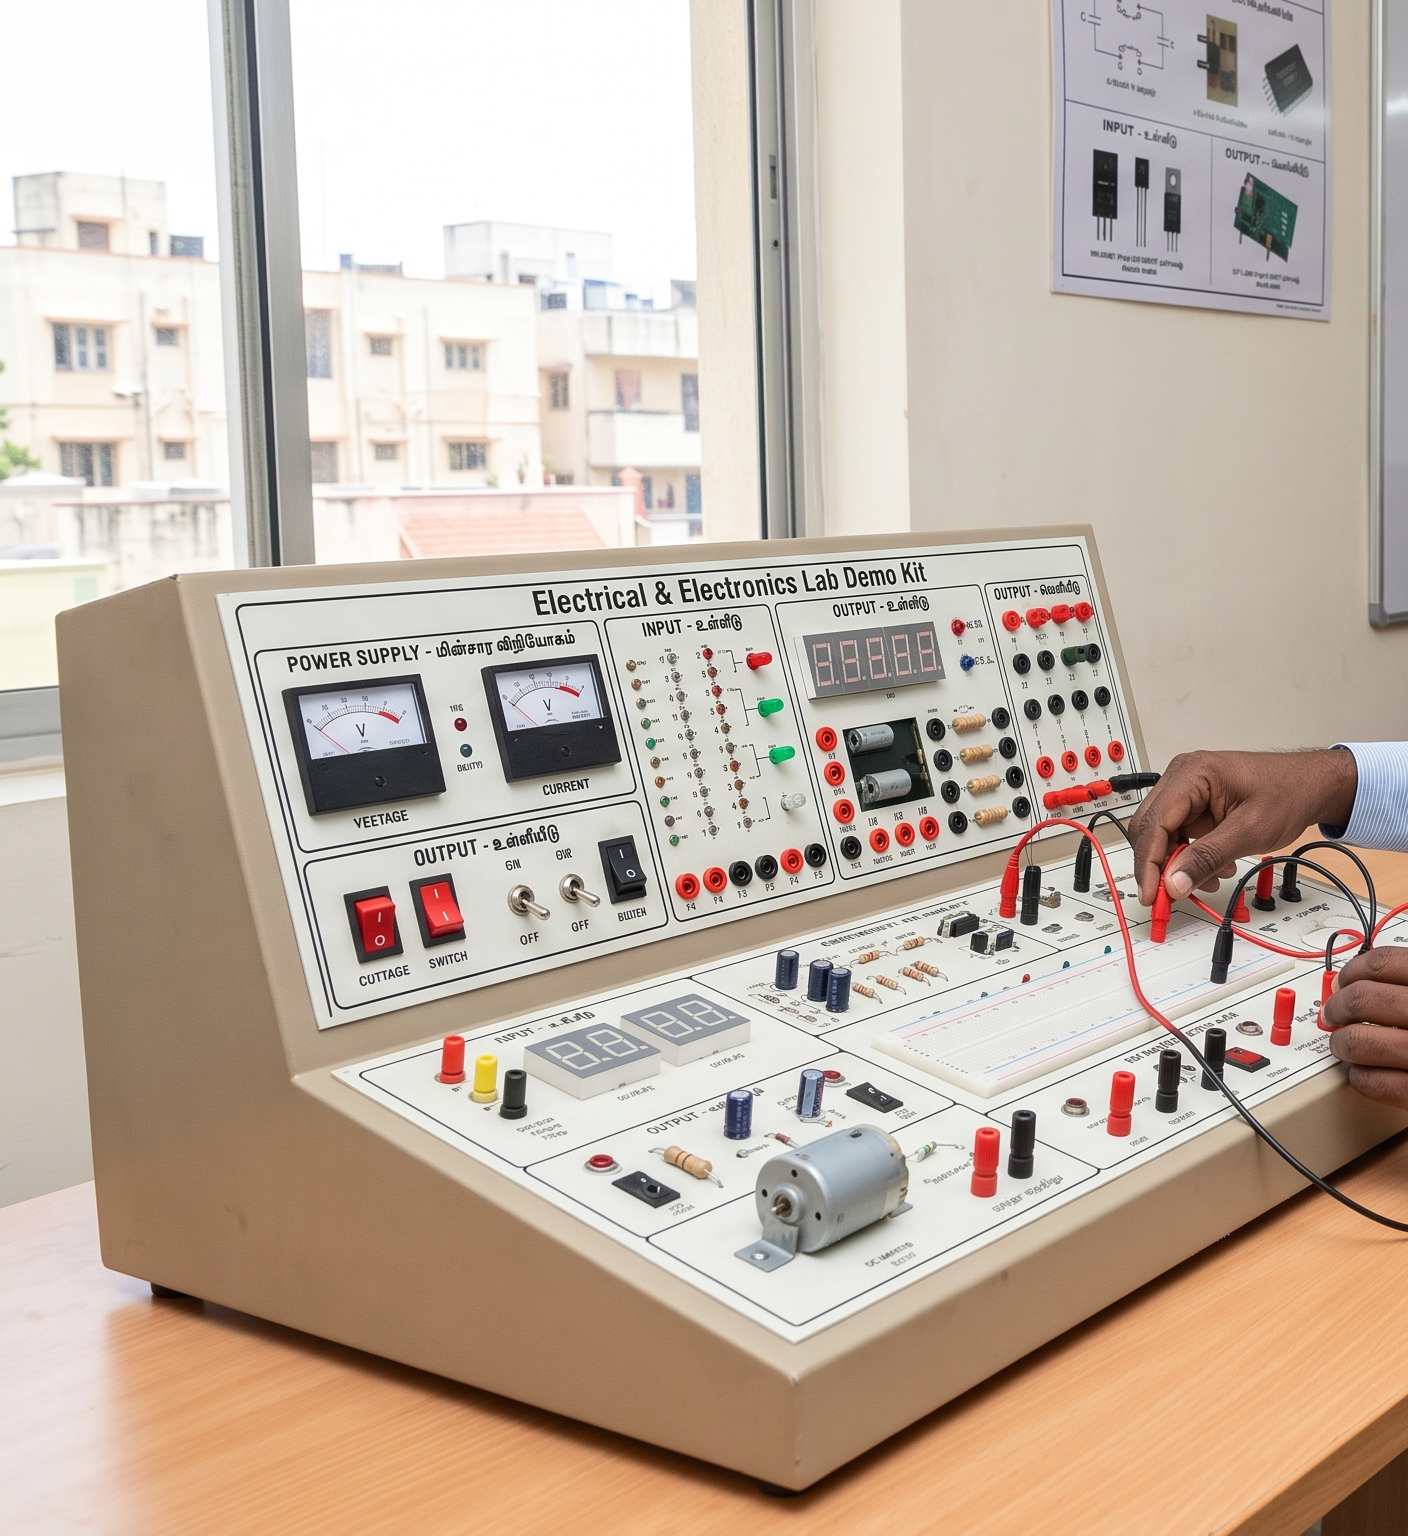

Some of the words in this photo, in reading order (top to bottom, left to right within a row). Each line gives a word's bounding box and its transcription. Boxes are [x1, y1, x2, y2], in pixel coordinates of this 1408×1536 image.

[1102, 118, 1135, 137] INPUT
[1225, 147, 1261, 165] OUTPUT
[532, 582, 648, 616] Electrical
[655, 580, 673, 606] &
[677, 571, 798, 602] Electronics
[801, 567, 839, 593] Lab
[842, 564, 897, 589] Demo
[900, 561, 928, 585] Kit
[994, 585, 1031, 601] OUTPUT
[832, 600, 876, 618] OUTPUT
[641, 619, 682, 637] INPUT
[286, 651, 353, 673] POWER
[356, 644, 420, 666] SUPPLY
[436, 639, 493, 658] மின்சார
[542, 698, 551, 712] V
[355, 722, 366, 738] V
[542, 777, 591, 797] CURRENT
[353, 809, 409, 830] VEETAGE
[413, 838, 477, 867] OUTPUT
[571, 919, 590, 932] OFF
[519, 931, 540, 946] OFF
[428, 950, 469, 970] SWITCH
[358, 964, 411, 988] CUTTAGE
[646, 1111, 700, 1134] OUTPUT
